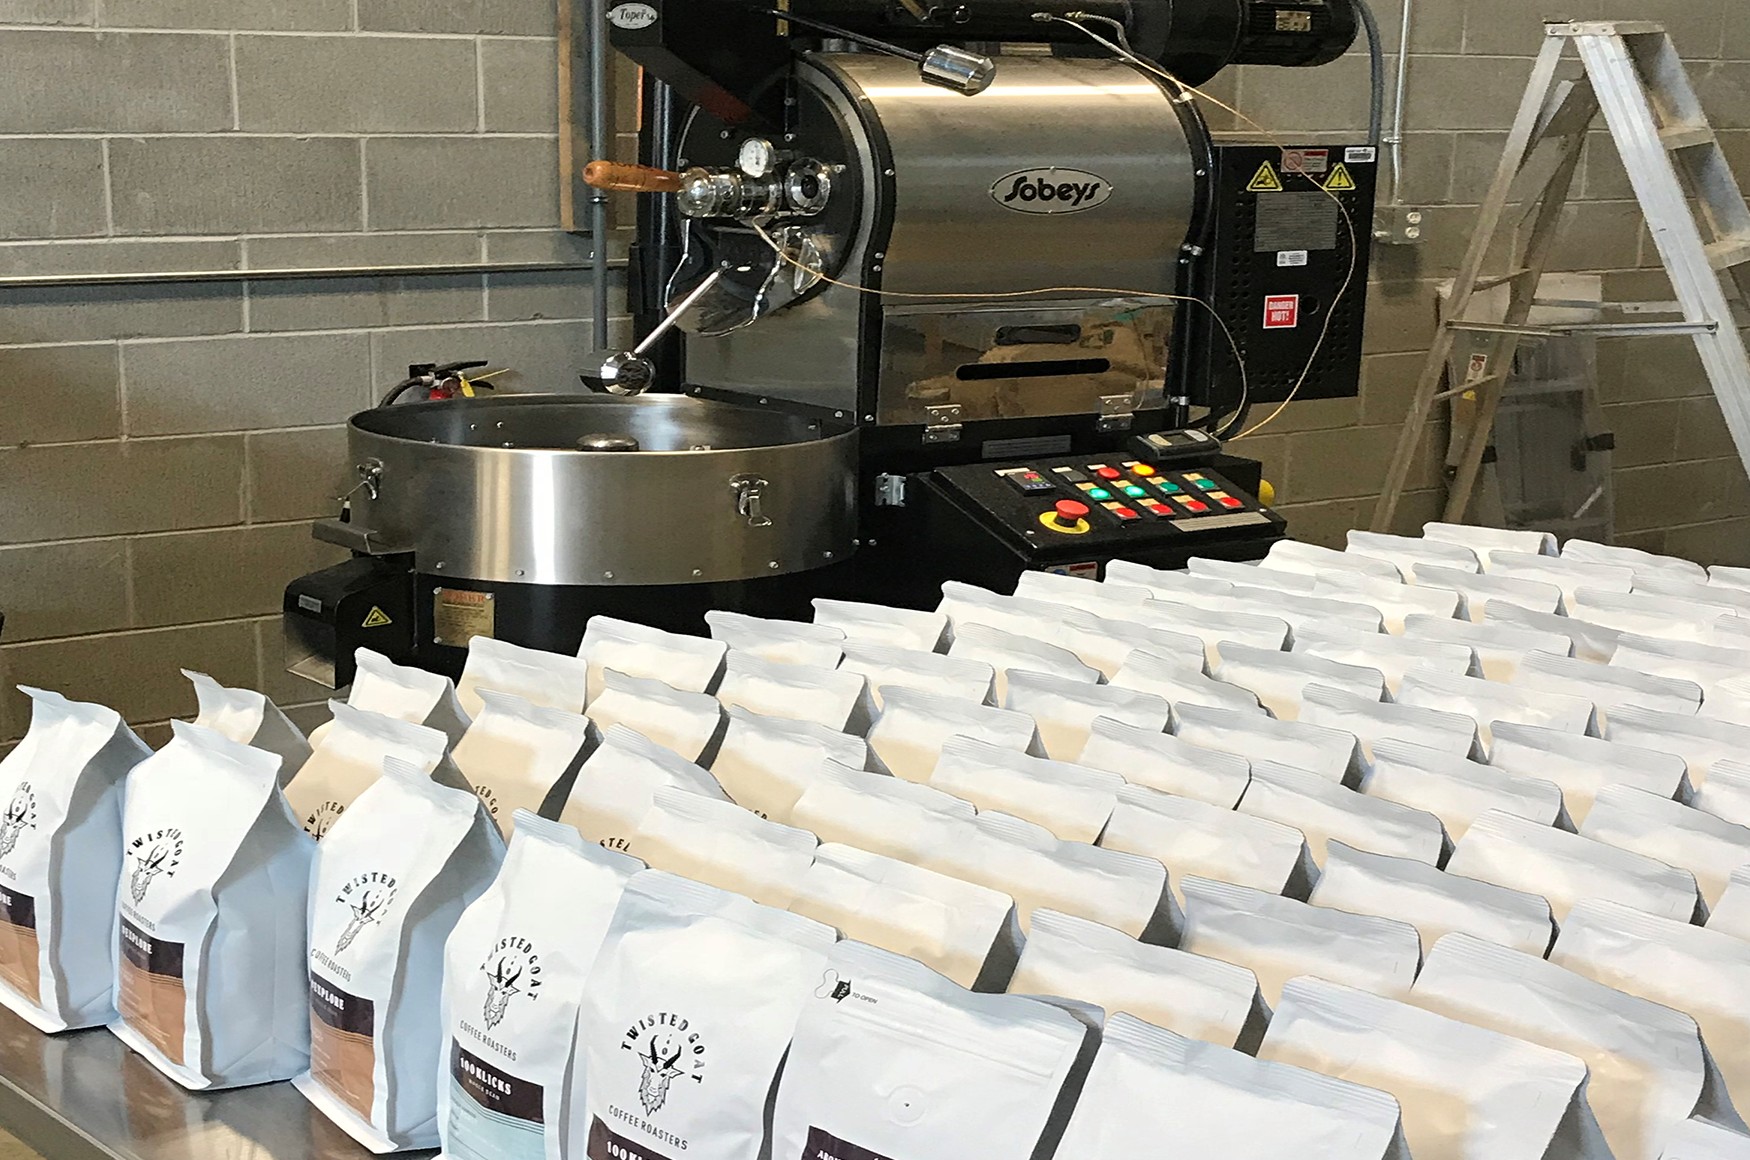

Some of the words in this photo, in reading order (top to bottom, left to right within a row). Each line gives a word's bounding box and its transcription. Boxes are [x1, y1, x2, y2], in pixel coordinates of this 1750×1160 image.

[1004, 176, 1100, 206] Sobeys
[126, 828, 181, 856] TWISTED
[335, 872, 397, 904] TWISTED
[528, 954, 542, 1001] GOAT
[460, 1020, 481, 1041] COFFEE
[482, 1032, 517, 1062] ROASTERS
[621, 1012, 689, 1051] TWISTED
[688, 1033, 705, 1084] GOAT
[608, 1104, 639, 1128] COFFEE
[640, 1120, 688, 1151] ROASTERS
